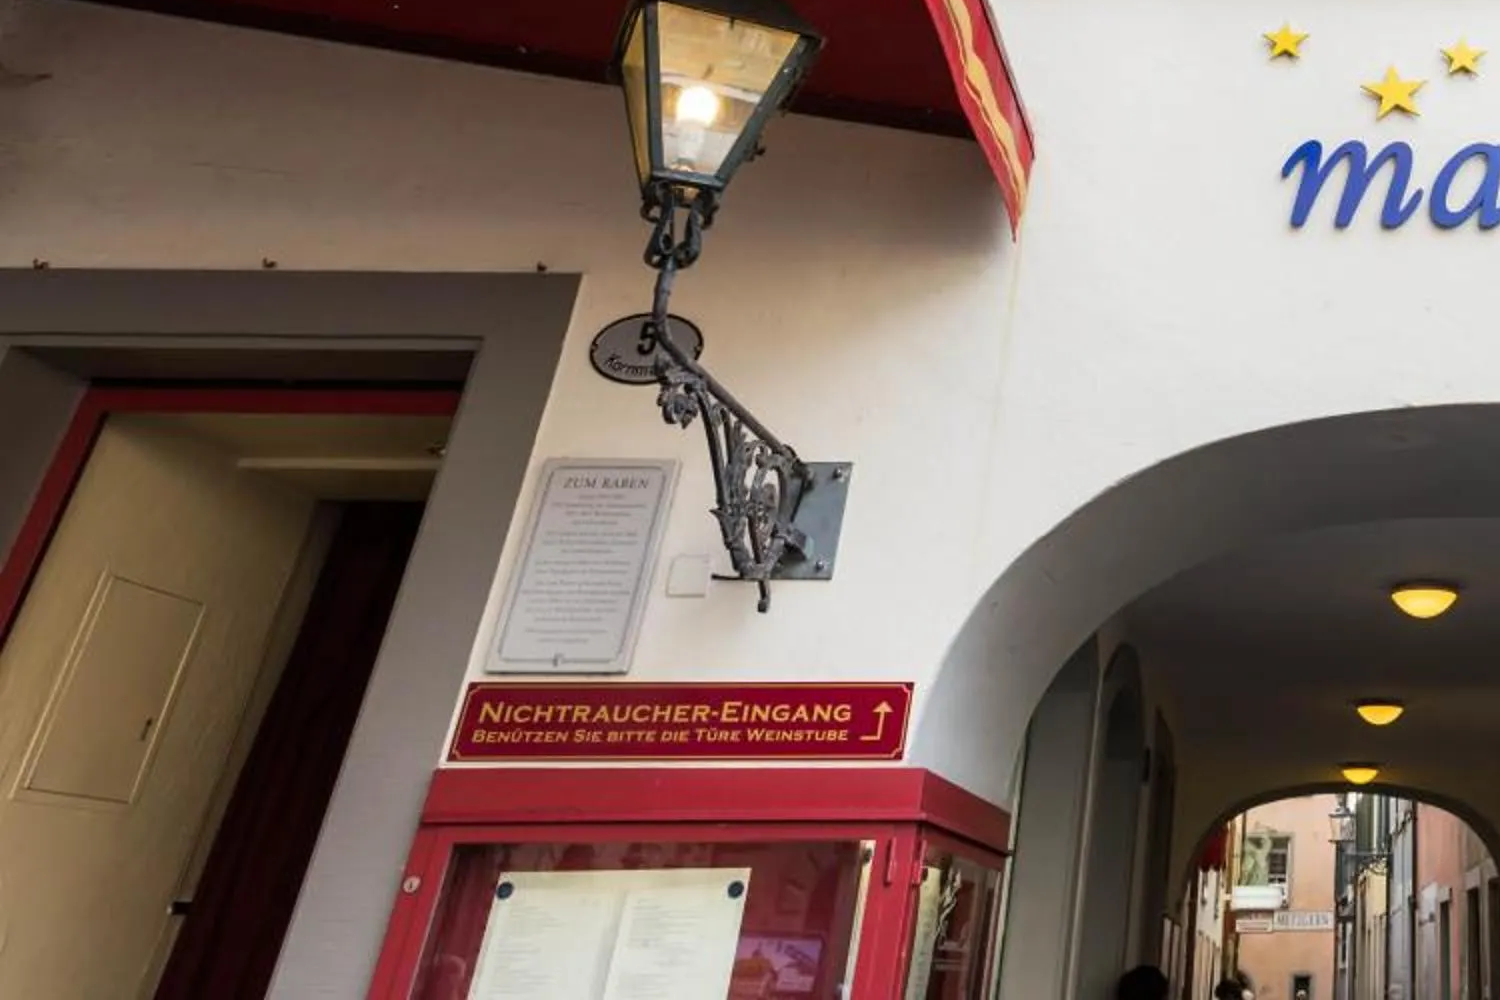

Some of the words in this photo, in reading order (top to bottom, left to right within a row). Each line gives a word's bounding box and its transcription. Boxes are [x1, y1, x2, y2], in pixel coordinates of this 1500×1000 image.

[563, 477, 598, 489] ZUM
[573, 729, 602, 743] SIE
[660, 729, 690, 743] DIE
[747, 728, 848, 742] WEINSTUBE
